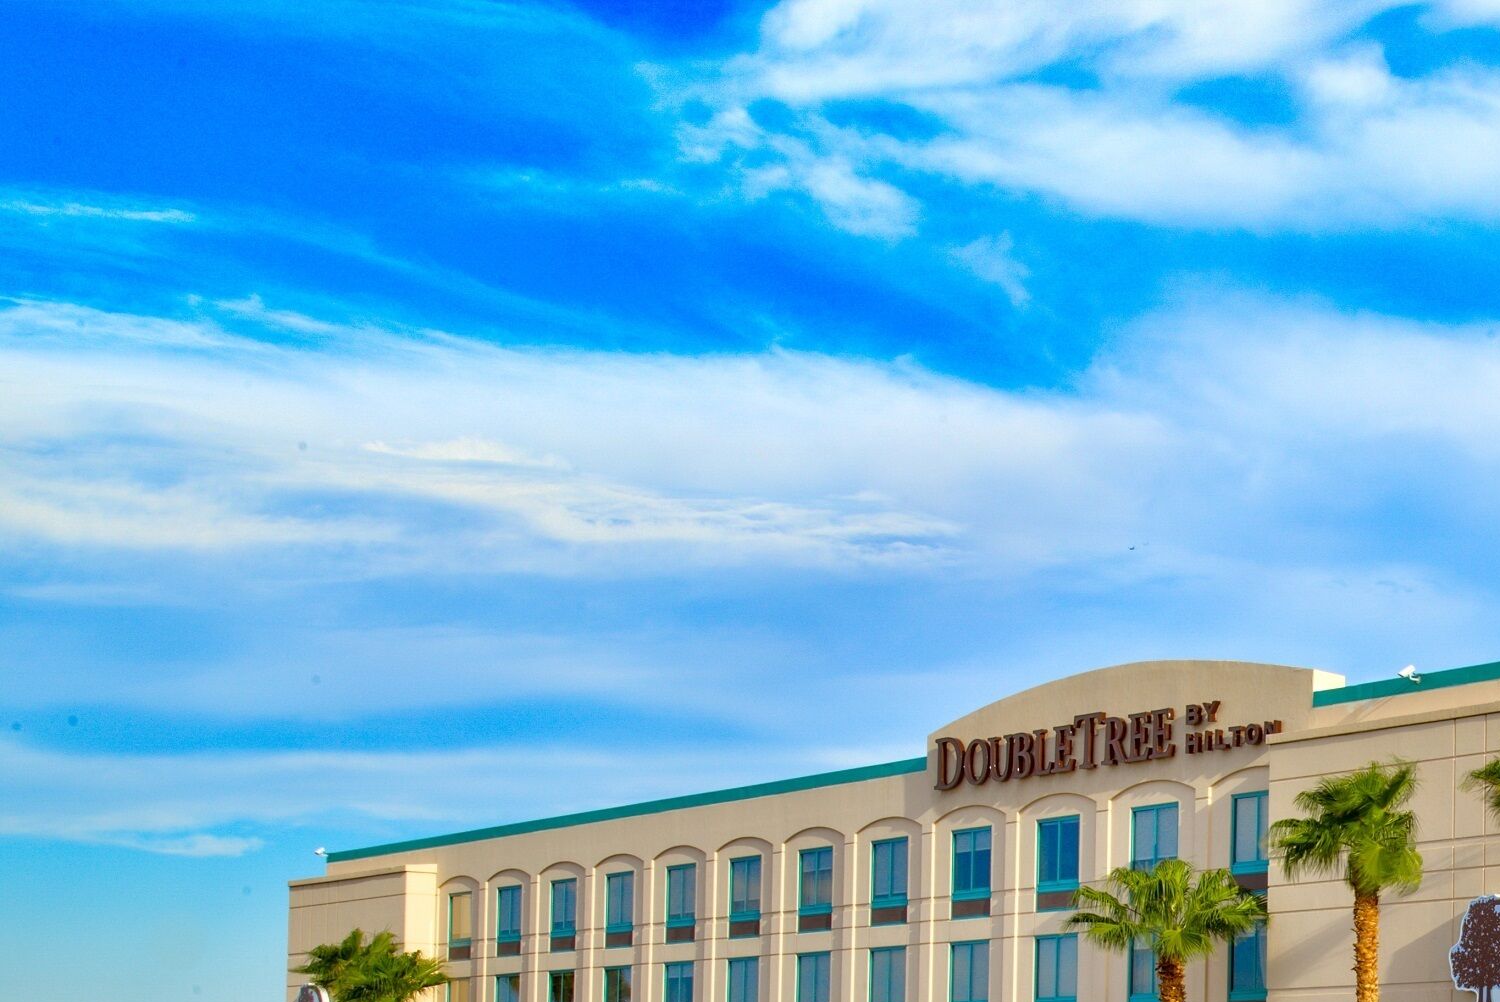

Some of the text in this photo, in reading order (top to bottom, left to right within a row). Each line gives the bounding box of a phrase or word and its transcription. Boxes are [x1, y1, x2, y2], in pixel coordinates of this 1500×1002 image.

[934, 700, 1221, 790] DOUBLETREE BY
[1185, 719, 1282, 754] HILTON
